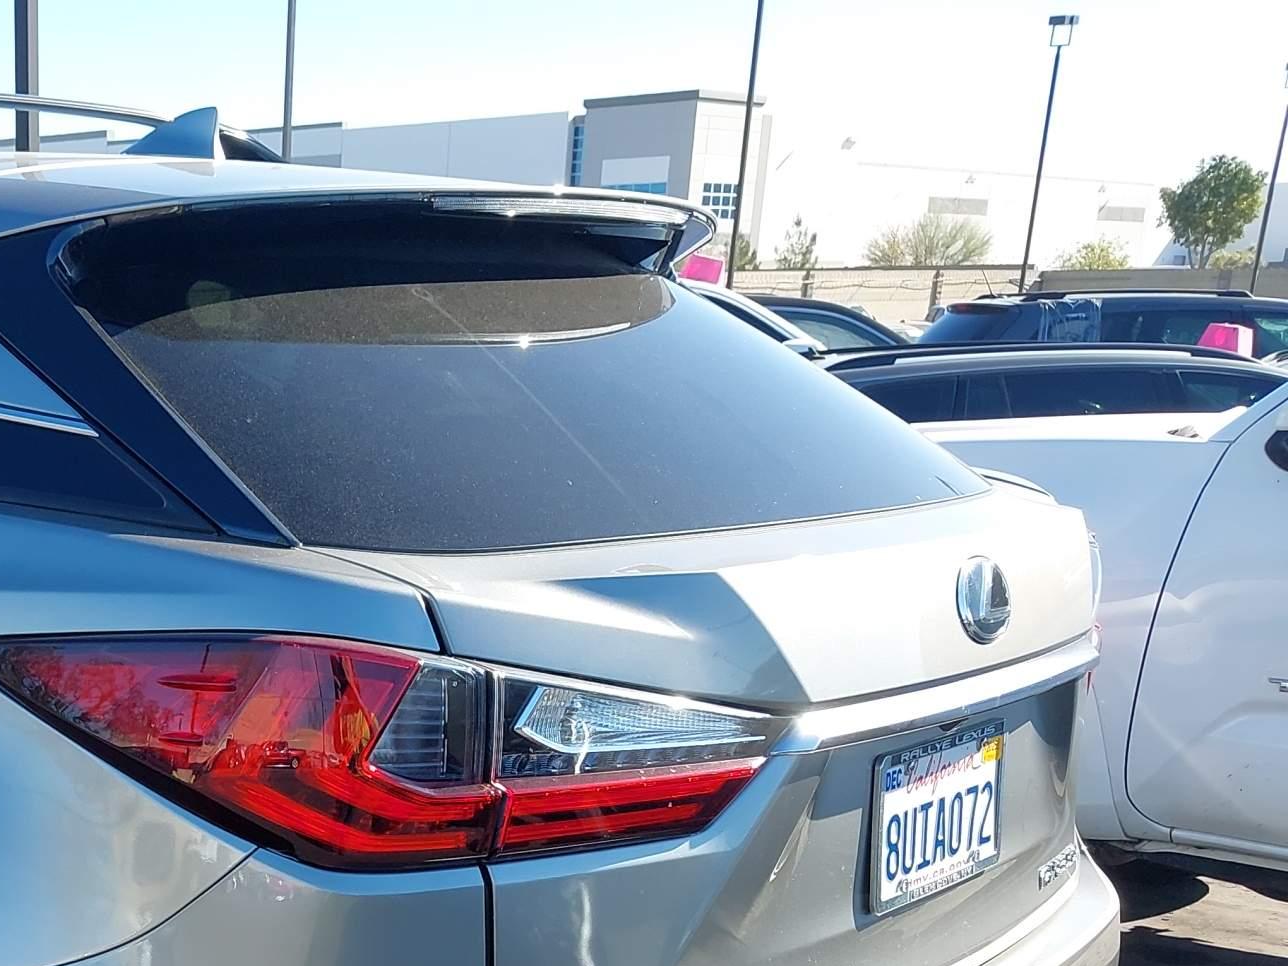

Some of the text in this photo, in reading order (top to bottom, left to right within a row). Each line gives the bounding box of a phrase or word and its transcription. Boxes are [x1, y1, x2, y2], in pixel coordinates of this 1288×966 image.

[900, 725, 996, 763] RALLYE LEXUS
[885, 768, 903, 792] DEC
[906, 750, 980, 795] California
[886, 781, 993, 882] 8UIA072
